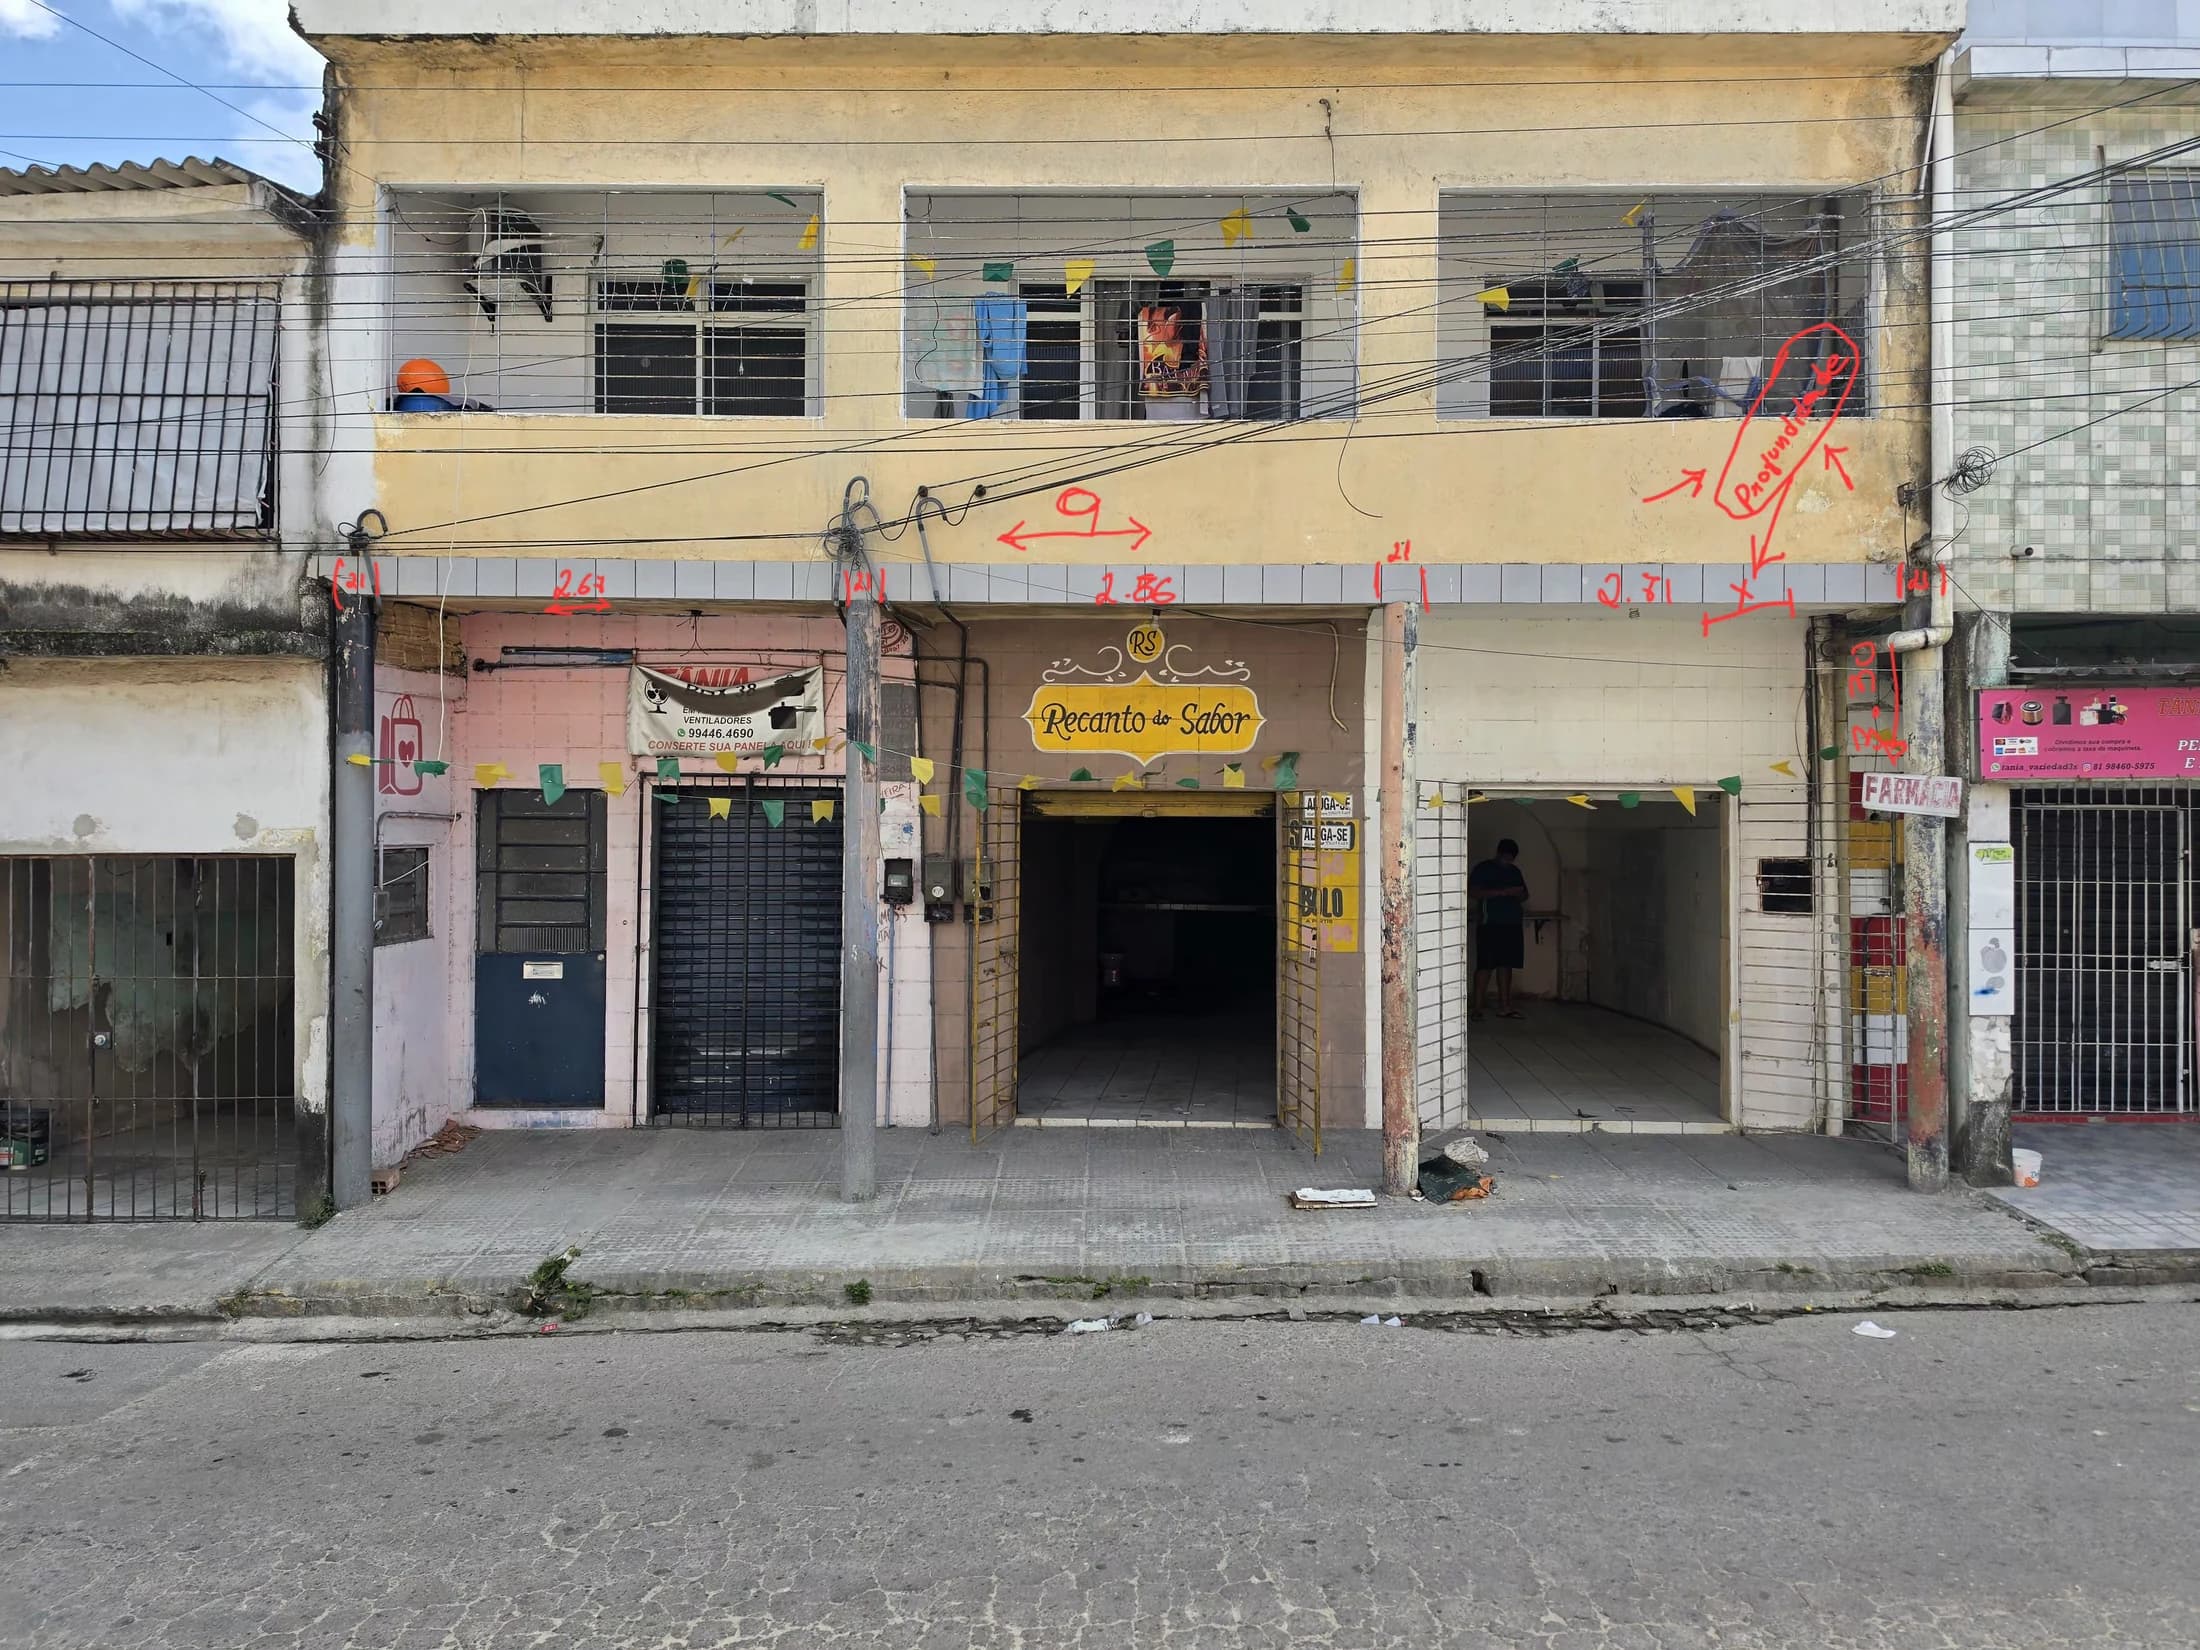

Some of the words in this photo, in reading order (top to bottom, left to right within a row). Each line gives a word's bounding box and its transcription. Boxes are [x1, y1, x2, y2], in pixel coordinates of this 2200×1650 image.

[1129, 630, 1158, 657] RS
[2159, 696, 2200, 716] TÂN
[683, 716, 752, 725] VENTILADORES
[1041, 702, 1146, 741] Recanto
[1152, 709, 1172, 726] do
[1180, 702, 1251, 735] Sabor
[688, 728, 754, 739] 99446.4690
[648, 740, 706, 751] CONSERTE
[709, 741, 732, 751] SUA
[2177, 739, 2200, 751] PE
[2105, 762, 2155, 771] 98460-5975
[2184, 757, 2196, 769] E
[1304, 827, 1348, 842] ALGA-SE
